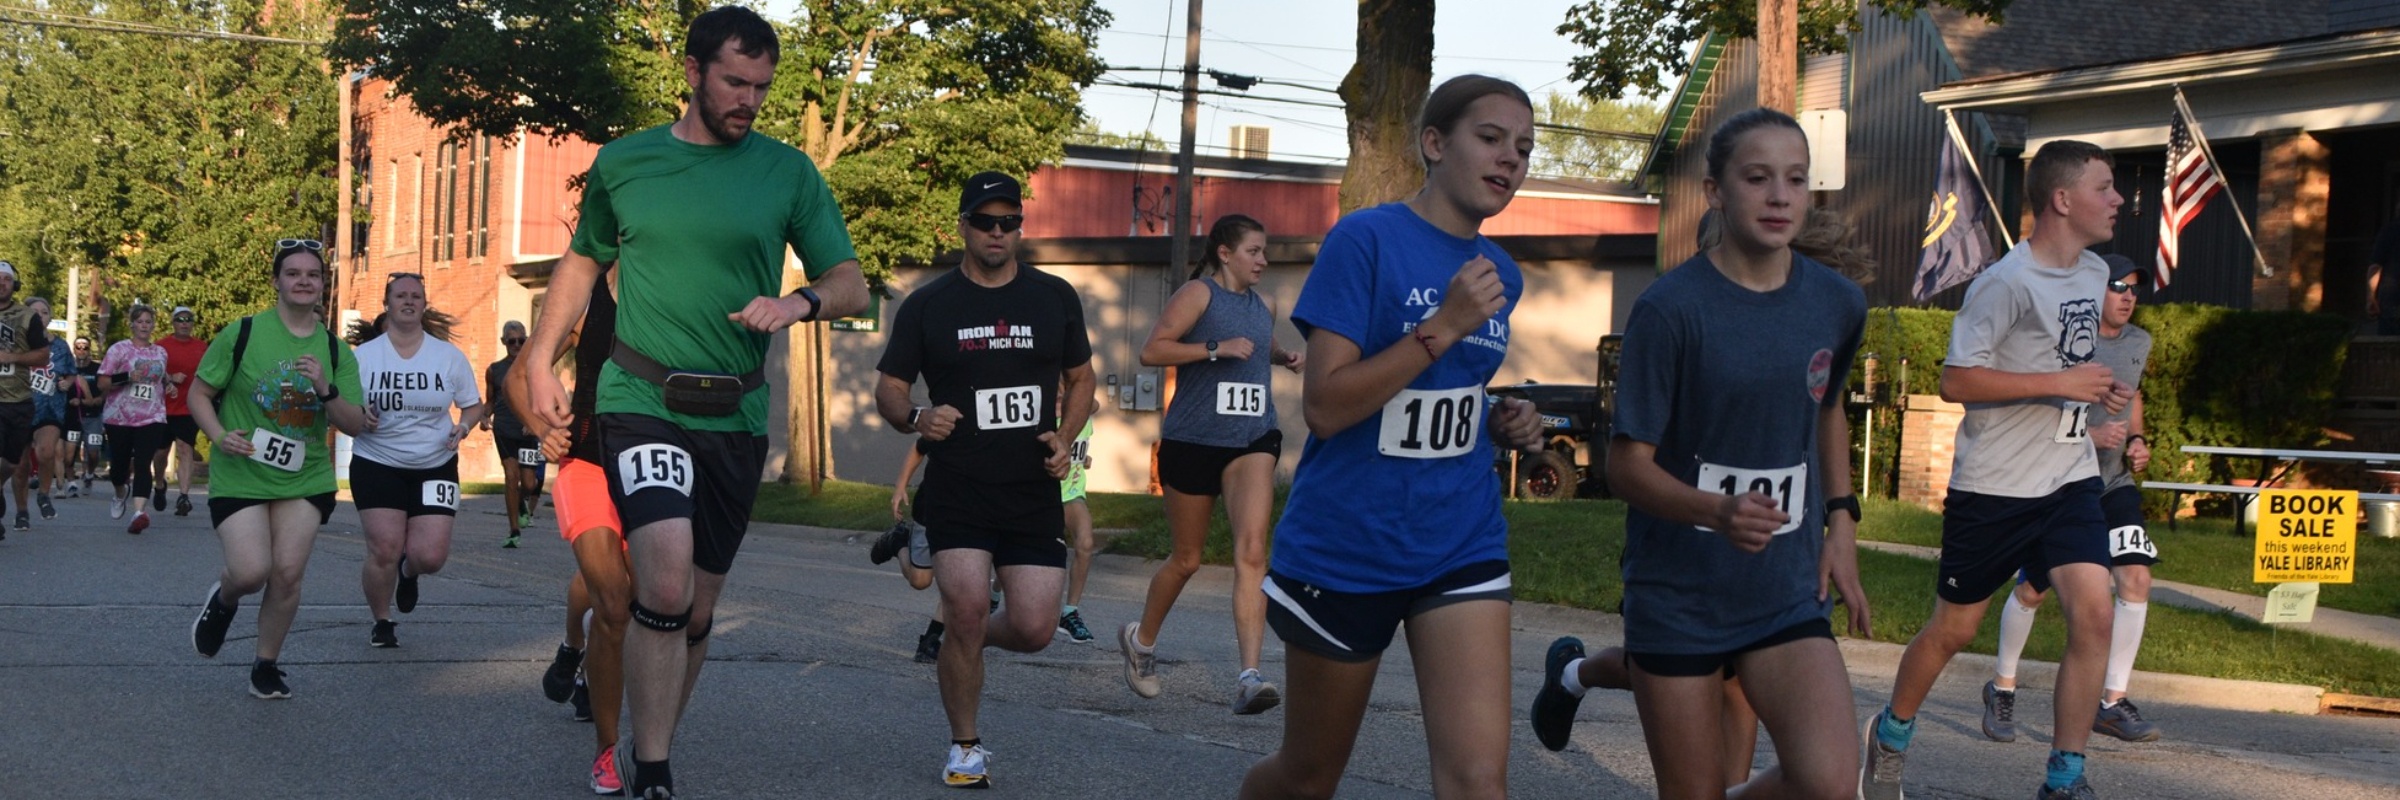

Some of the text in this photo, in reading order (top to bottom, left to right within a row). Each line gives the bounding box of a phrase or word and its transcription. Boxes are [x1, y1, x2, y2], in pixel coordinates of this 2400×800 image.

[1405, 287, 1438, 306] AC
[958, 338, 1034, 352] 70.3 MICHIGAN
[31, 374, 49, 391] 151
[134, 385, 152, 399] 121
[369, 371, 445, 392] I NEED A
[988, 390, 1035, 424] 163
[1226, 386, 1260, 413] 115
[1400, 394, 1475, 451] 108
[263, 436, 296, 466] 55
[631, 449, 686, 488] 155
[436, 483, 455, 506] 93
[2270, 494, 2345, 515] BOOK
[2279, 518, 2335, 537] SALE
[2265, 540, 2347, 554] this weekend
[2259, 555, 2350, 571] YALE LIBRARY
